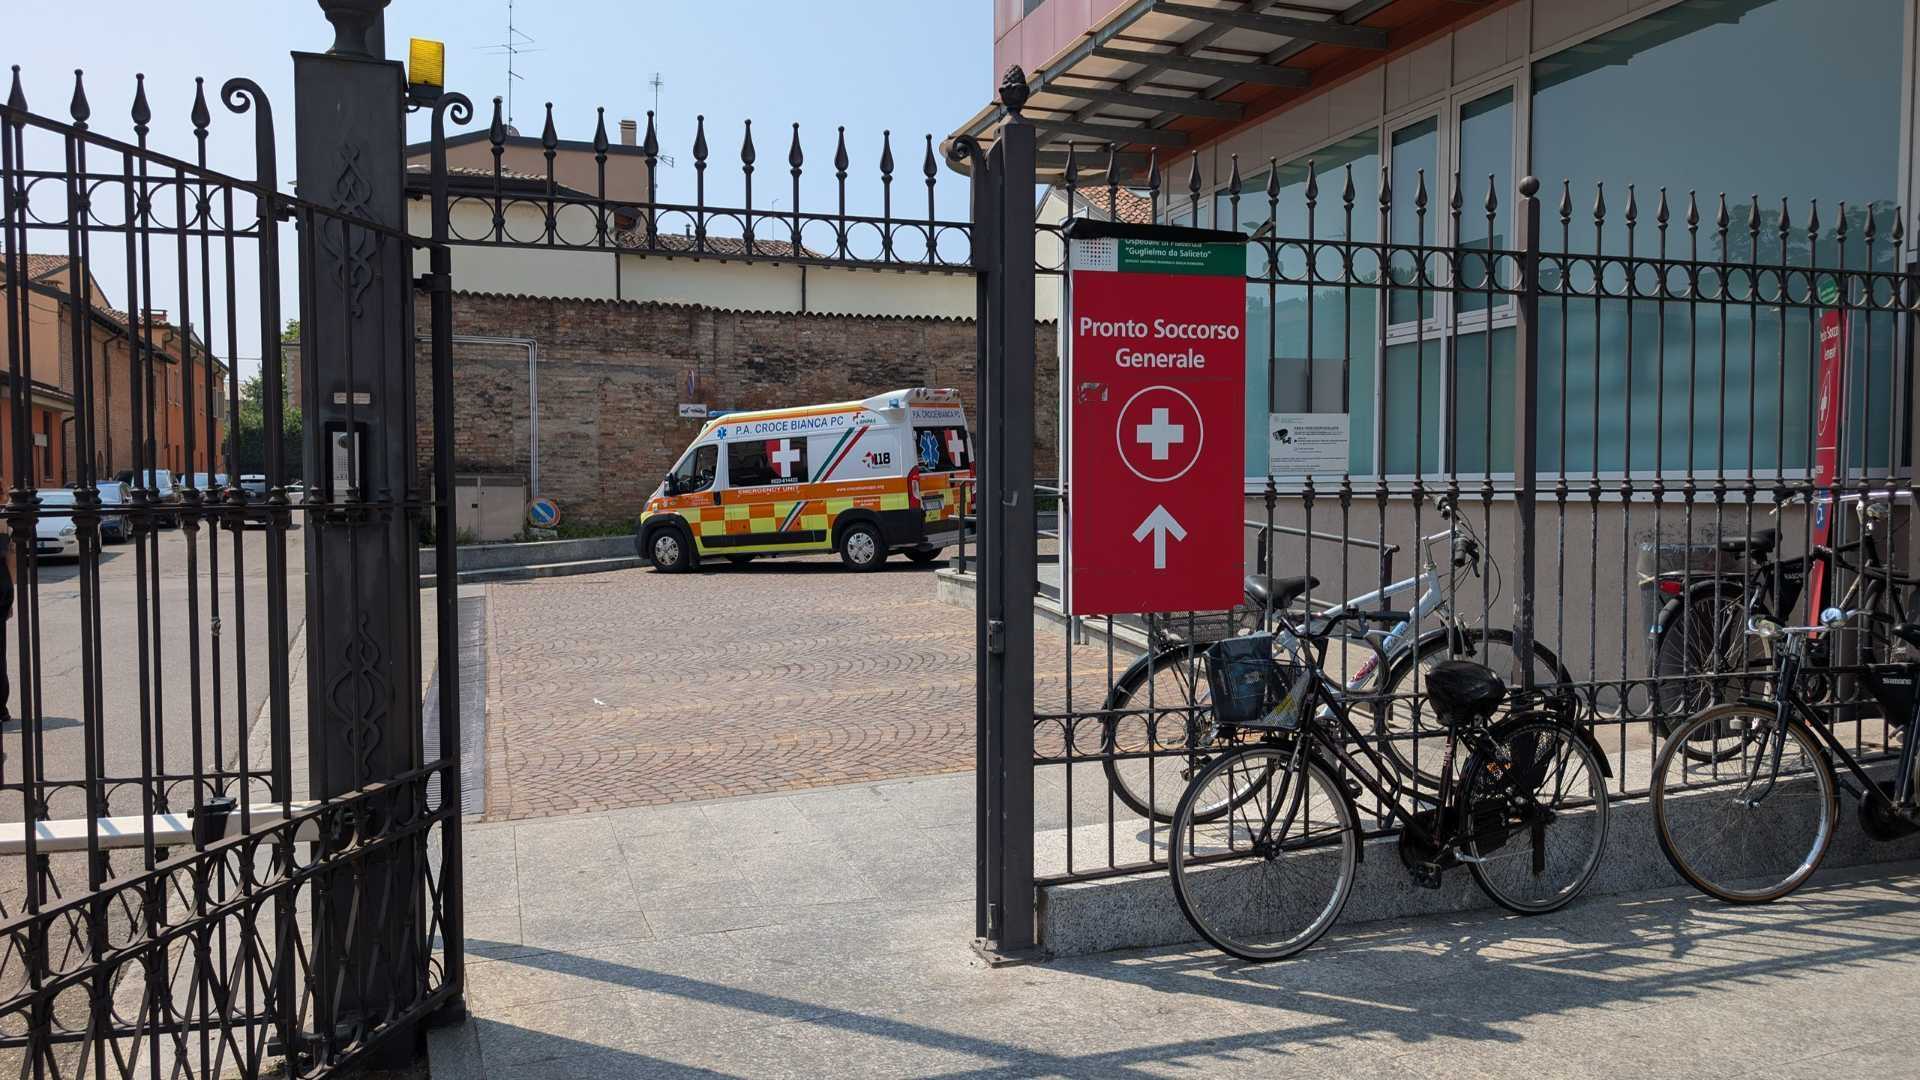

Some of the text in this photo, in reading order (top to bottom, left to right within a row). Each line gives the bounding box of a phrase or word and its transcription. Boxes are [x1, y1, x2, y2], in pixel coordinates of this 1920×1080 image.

[1079, 316, 1240, 340] Pronto Soccorso
[1115, 348, 1206, 368] Generale
[754, 421, 789, 434] CROCE
[791, 416, 828, 430] BIANCA
[830, 415, 844, 426] PC
[874, 452, 891, 465] 118
